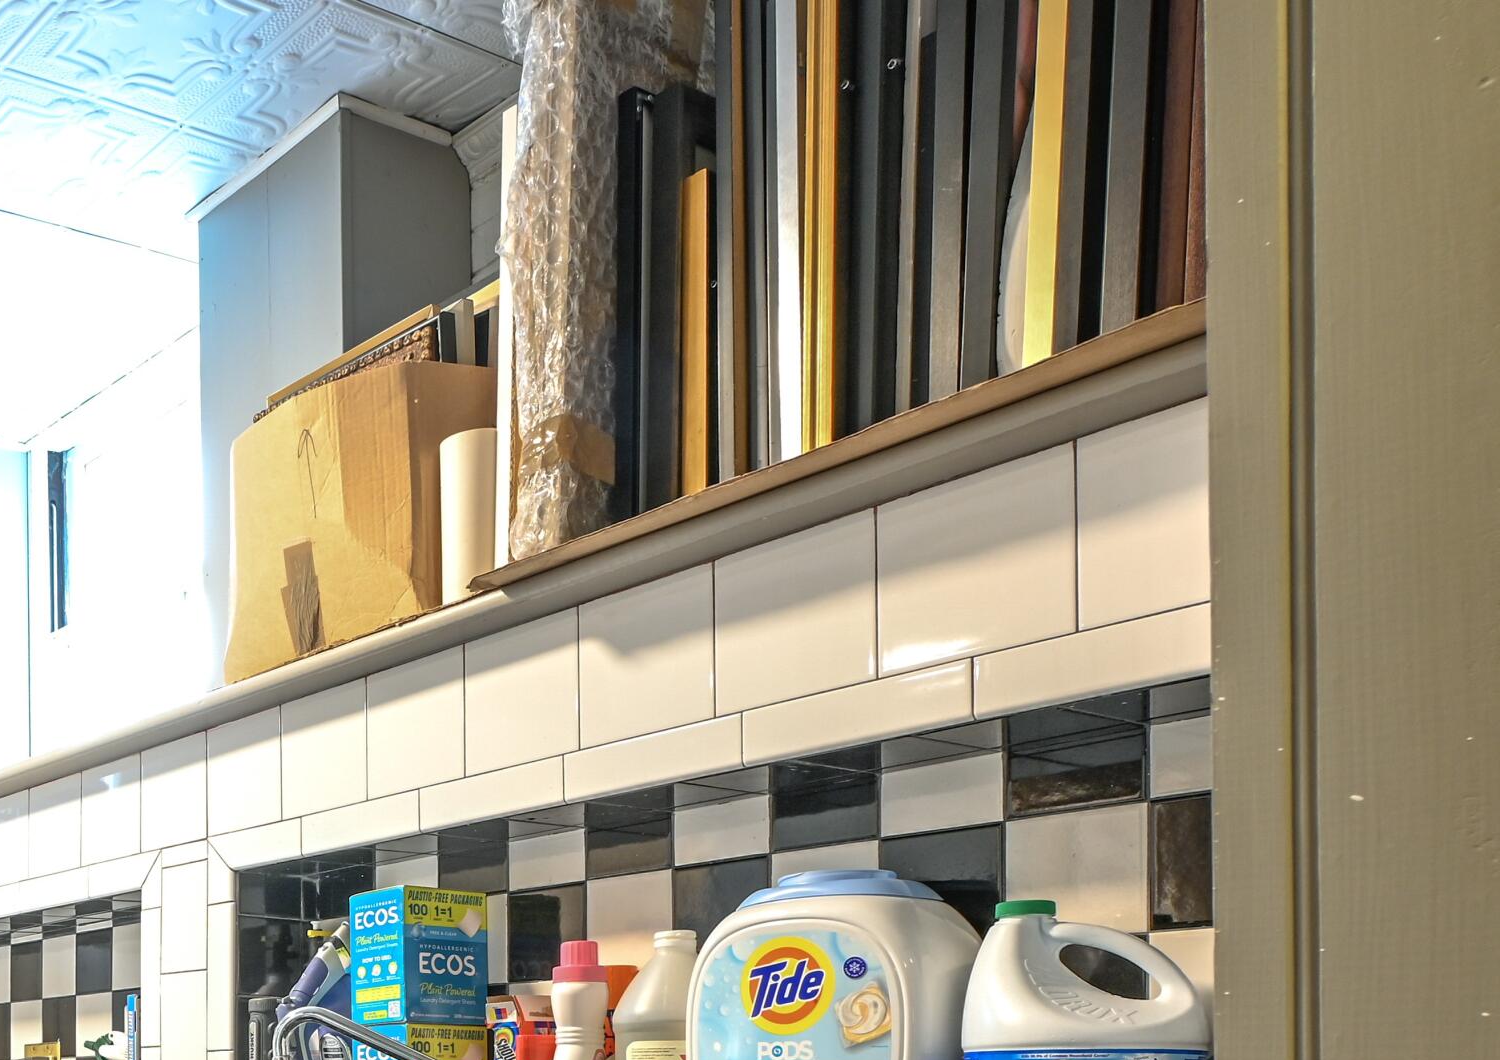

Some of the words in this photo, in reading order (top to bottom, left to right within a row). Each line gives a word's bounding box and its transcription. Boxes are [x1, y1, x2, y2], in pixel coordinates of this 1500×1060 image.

[408, 890, 449, 903] PLASTIC-FREE
[450, 893, 483, 907] PACKAGING
[408, 903, 428, 916] 100
[355, 906, 399, 930] ECOS
[355, 935, 372, 946] Plant
[373, 930, 398, 943] Powered
[420, 944, 474, 953] HYPOALLERGENIC
[419, 952, 476, 977] ECOS
[420, 982, 444, 995] Plant
[444, 983, 476, 997] Powered
[749, 958, 825, 1018] Tide
[411, 1028, 451, 1039] PLASTIC-FREE
[452, 1030, 484, 1040] PACKAGING
[411, 1041, 430, 1053] 100
[757, 1040, 814, 1060] PODS
